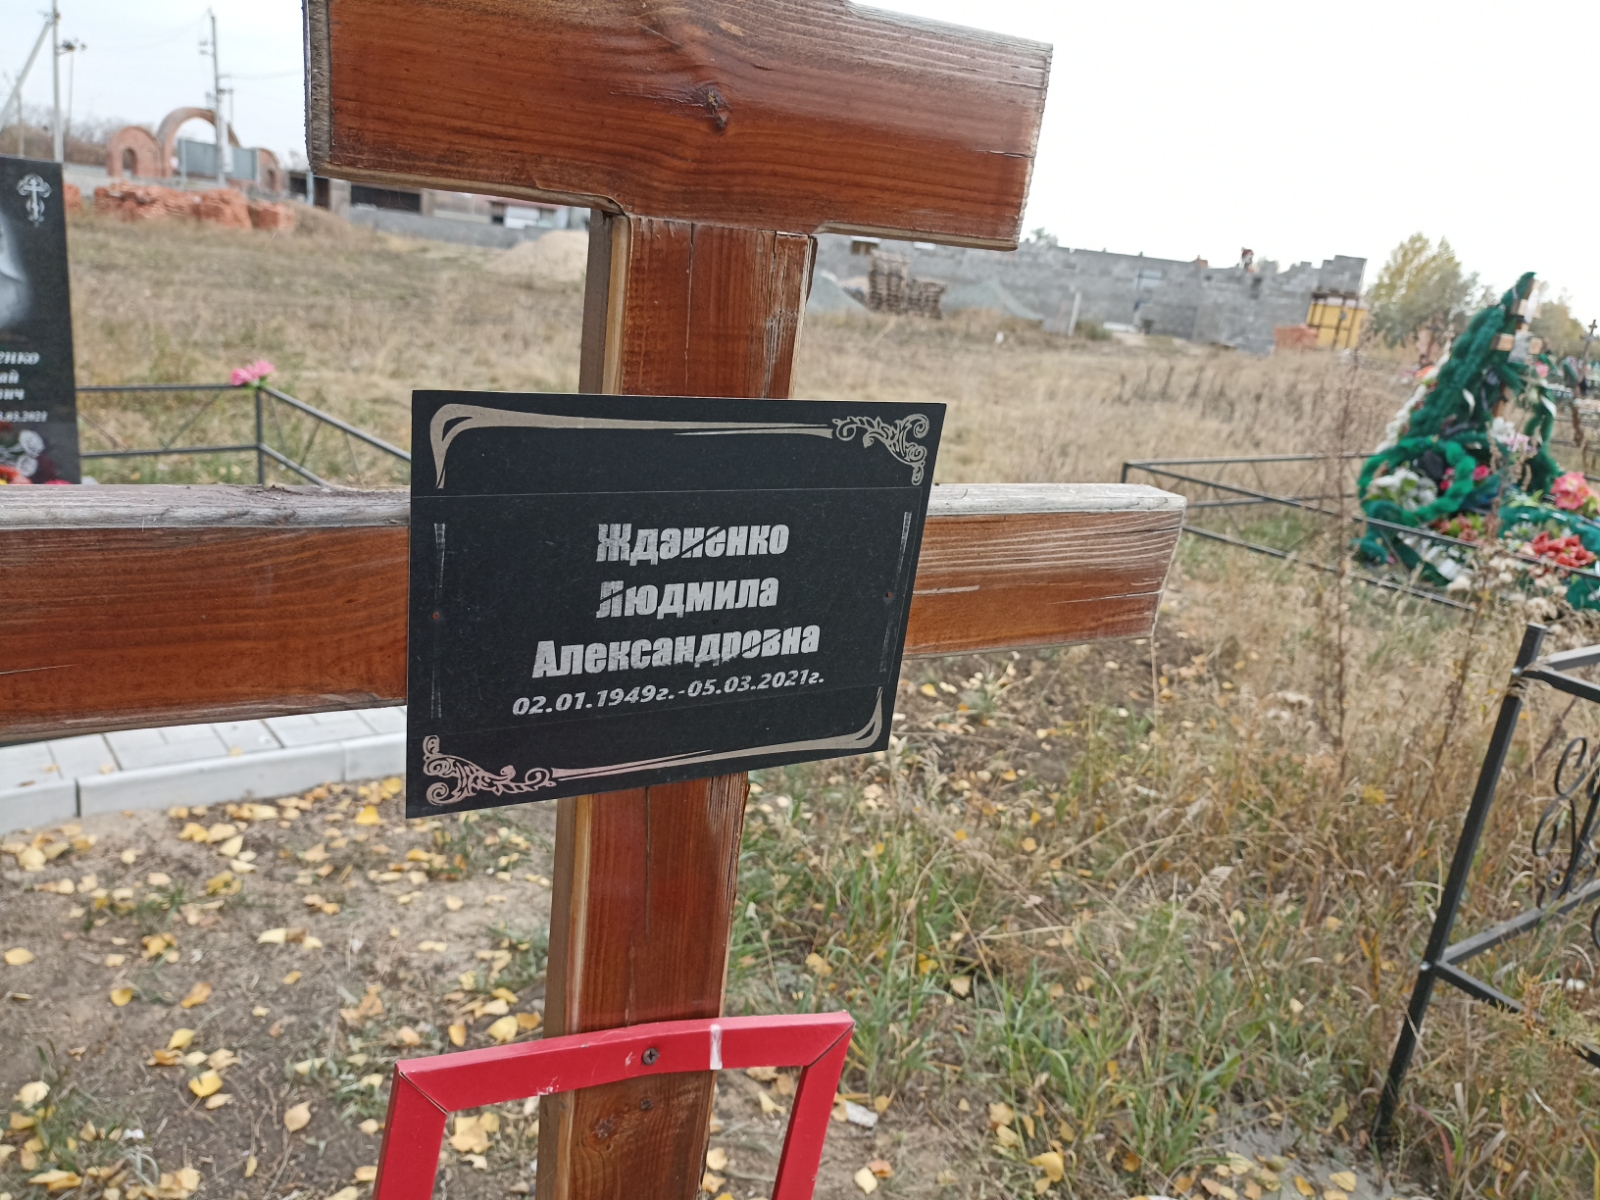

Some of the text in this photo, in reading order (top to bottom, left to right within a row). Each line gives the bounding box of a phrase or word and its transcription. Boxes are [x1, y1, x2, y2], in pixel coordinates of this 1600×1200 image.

[596, 523, 790, 566] Жданенко
[596, 577, 779, 619] Людмила
[532, 624, 821, 678] Александровна
